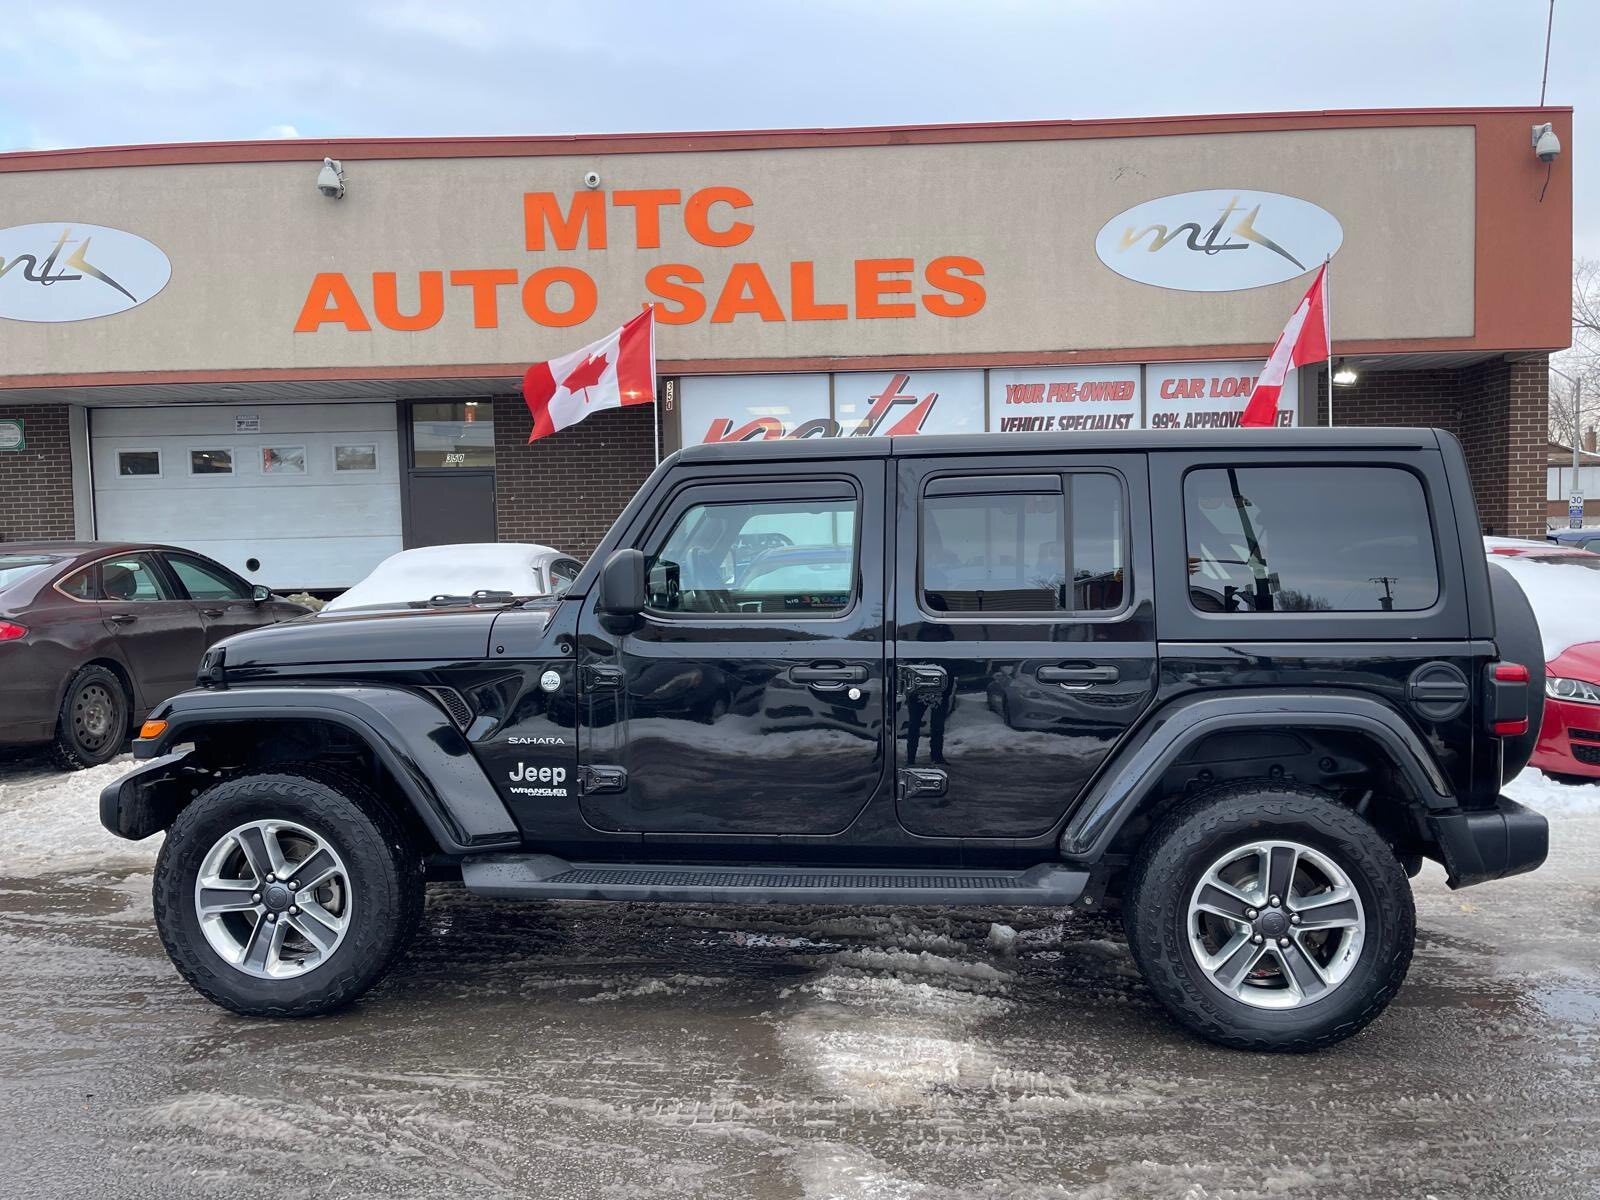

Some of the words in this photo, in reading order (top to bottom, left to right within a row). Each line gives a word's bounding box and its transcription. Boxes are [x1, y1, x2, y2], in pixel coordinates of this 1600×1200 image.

[523, 187, 755, 251] MTC
[294, 267, 598, 333] AUTO
[644, 256, 987, 326] SALES
[666, 380, 674, 411] 350
[1006, 384, 1045, 404] YOUR
[1047, 380, 1136, 402] PRE-OWNED
[1160, 378, 1206, 399] CAR
[1058, 412, 1134, 431] SPECIALIST
[1152, 412, 1181, 428] 99%
[1570, 496, 1582, 504] 30
[507, 737, 566, 745] SAHARA
[508, 761, 567, 786] Jeep
